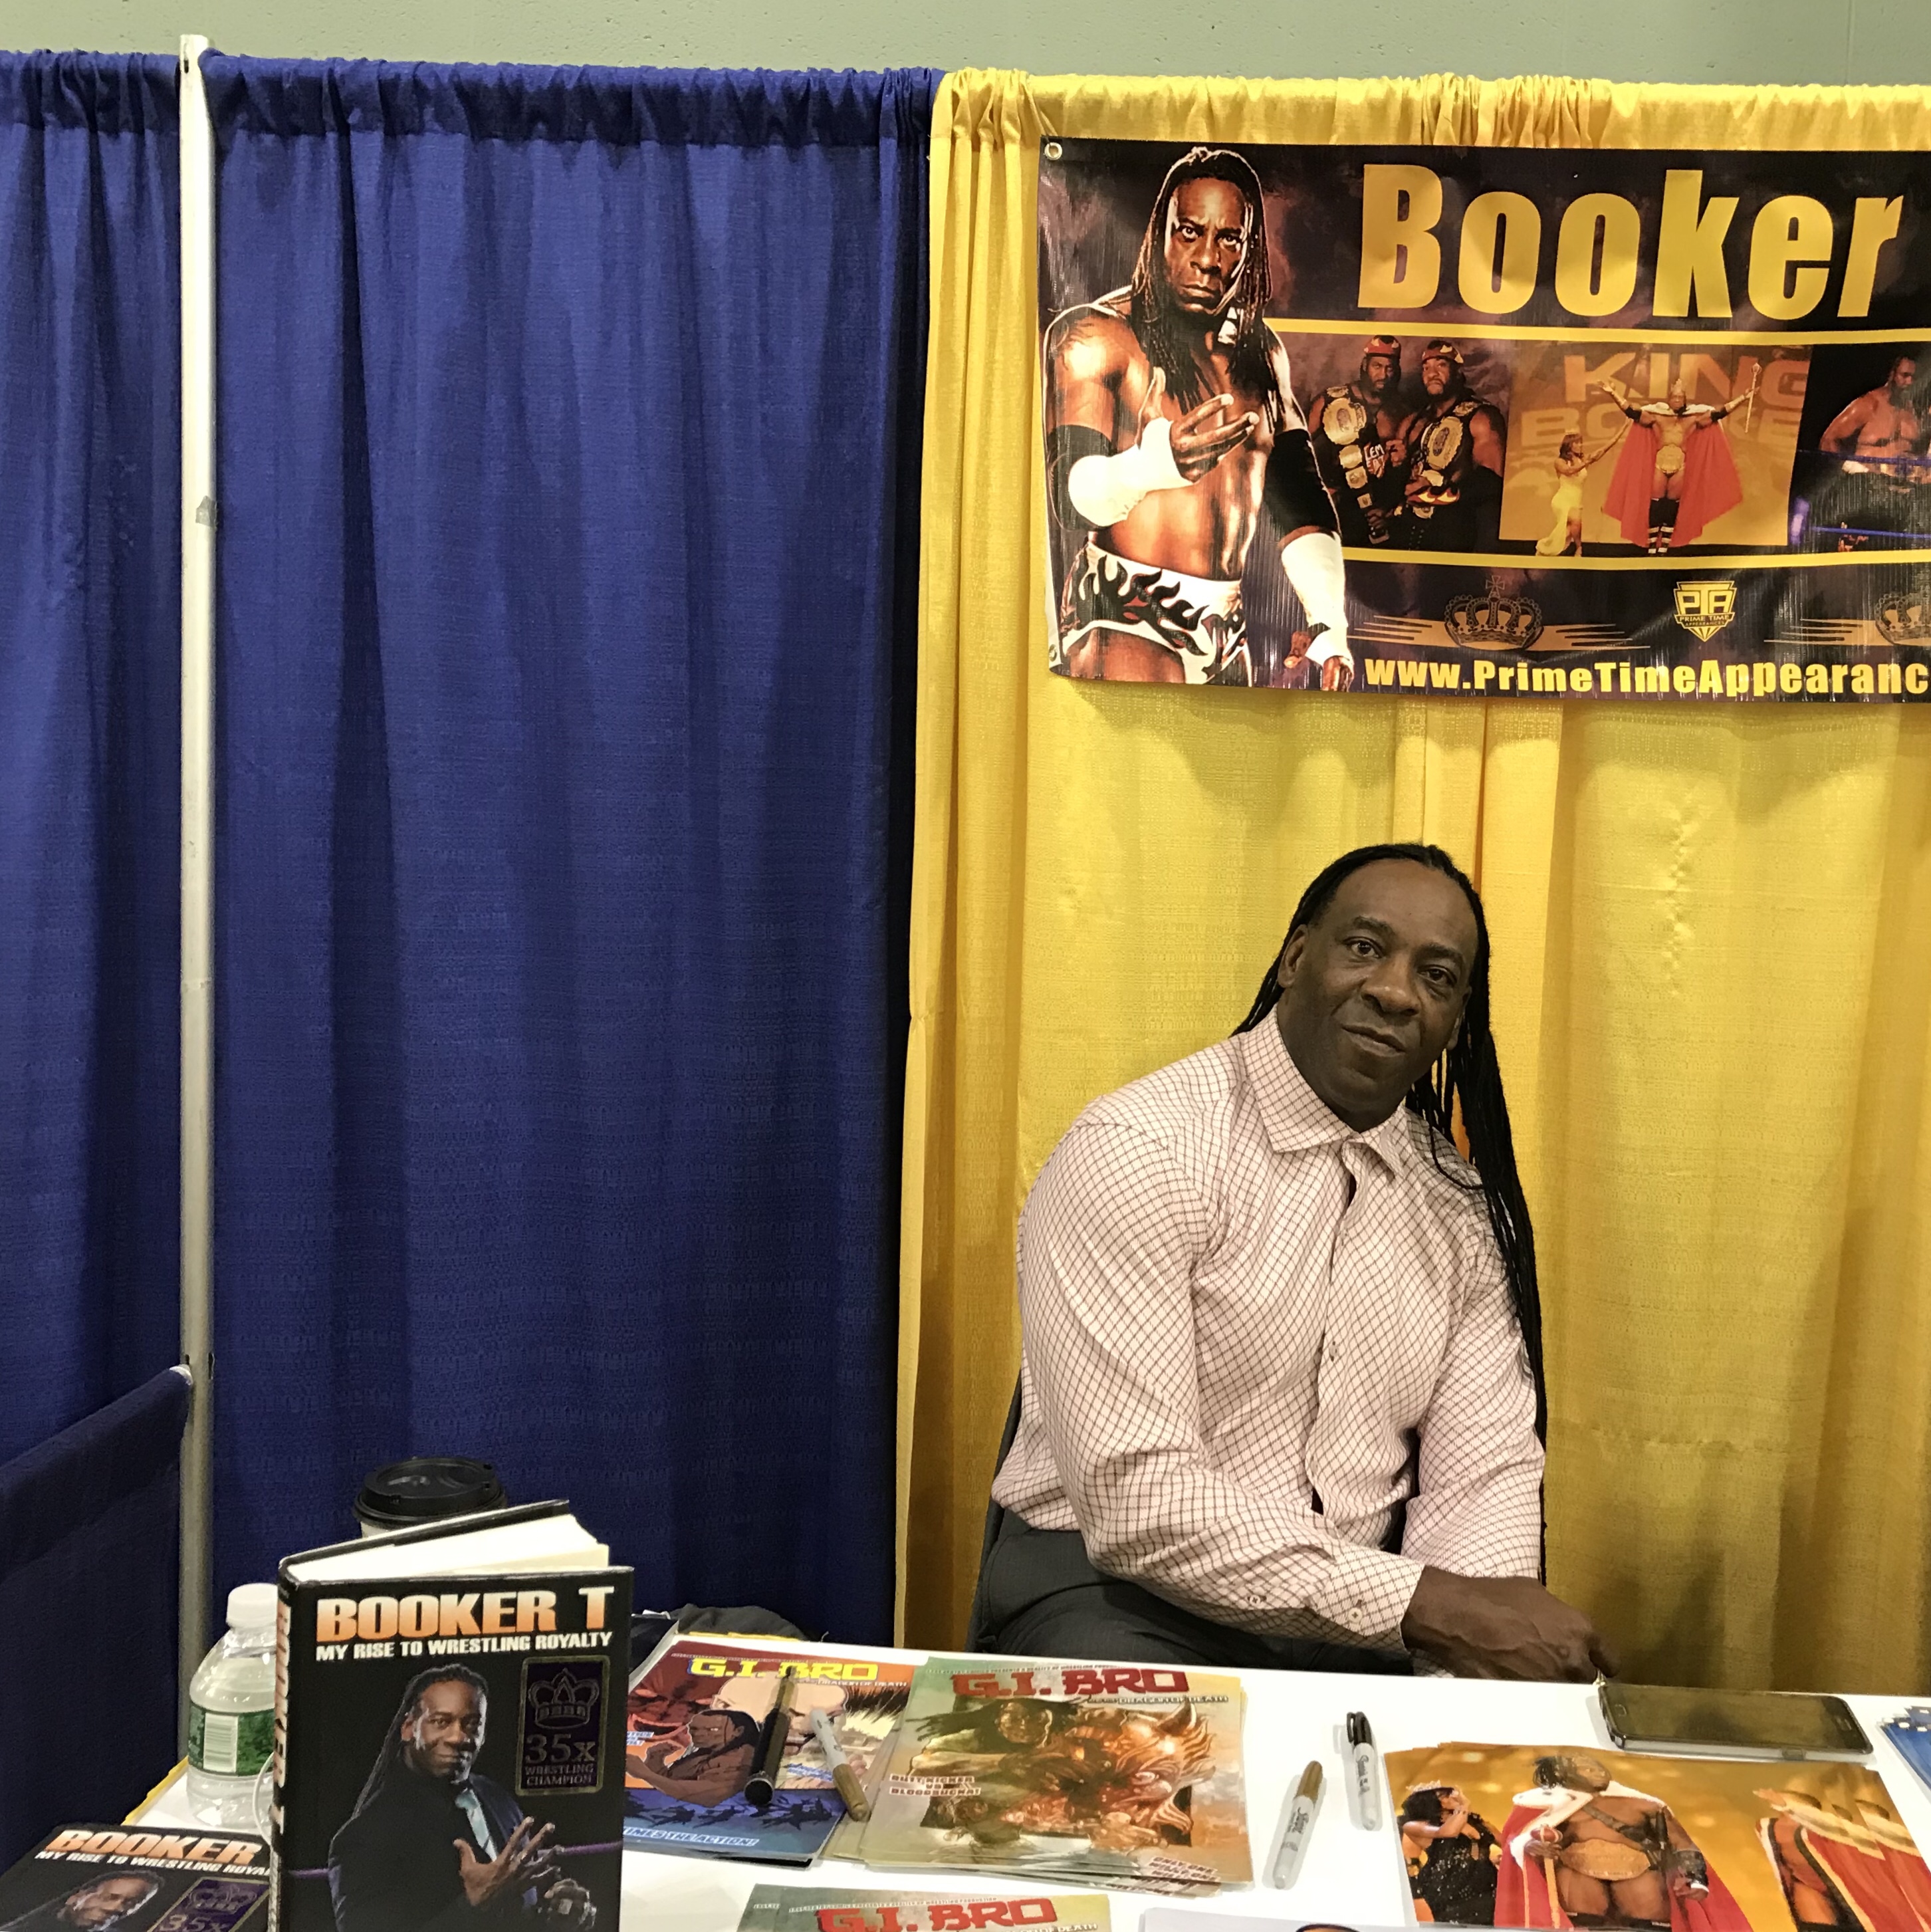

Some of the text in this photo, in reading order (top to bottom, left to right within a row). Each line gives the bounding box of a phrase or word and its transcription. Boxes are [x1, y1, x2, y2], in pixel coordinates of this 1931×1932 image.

[1357, 164, 1903, 320] Booker
[1676, 584, 1733, 615] PTA
[1365, 658, 1929, 697] www.PrimeTimeAppearanc
[316, 1586, 615, 1642] BOOKER T
[316, 1631, 613, 1661] MY RISE TO WRESTLING ROYALTY
[689, 1657, 767, 1678] G.I.
[950, 1668, 1190, 1697] G.I. BRO
[524, 1763, 594, 1776] WRESTLING
[526, 1774, 592, 1786] CHAMPION
[35, 1851, 66, 1860] MY
[66, 1852, 106, 1863] RISE
[106, 1855, 130, 1864] TO
[130, 1857, 223, 1872] WRESTLING
[44, 1830, 263, 1866] BOOKER
[928, 1898, 1058, 1931] BRO
